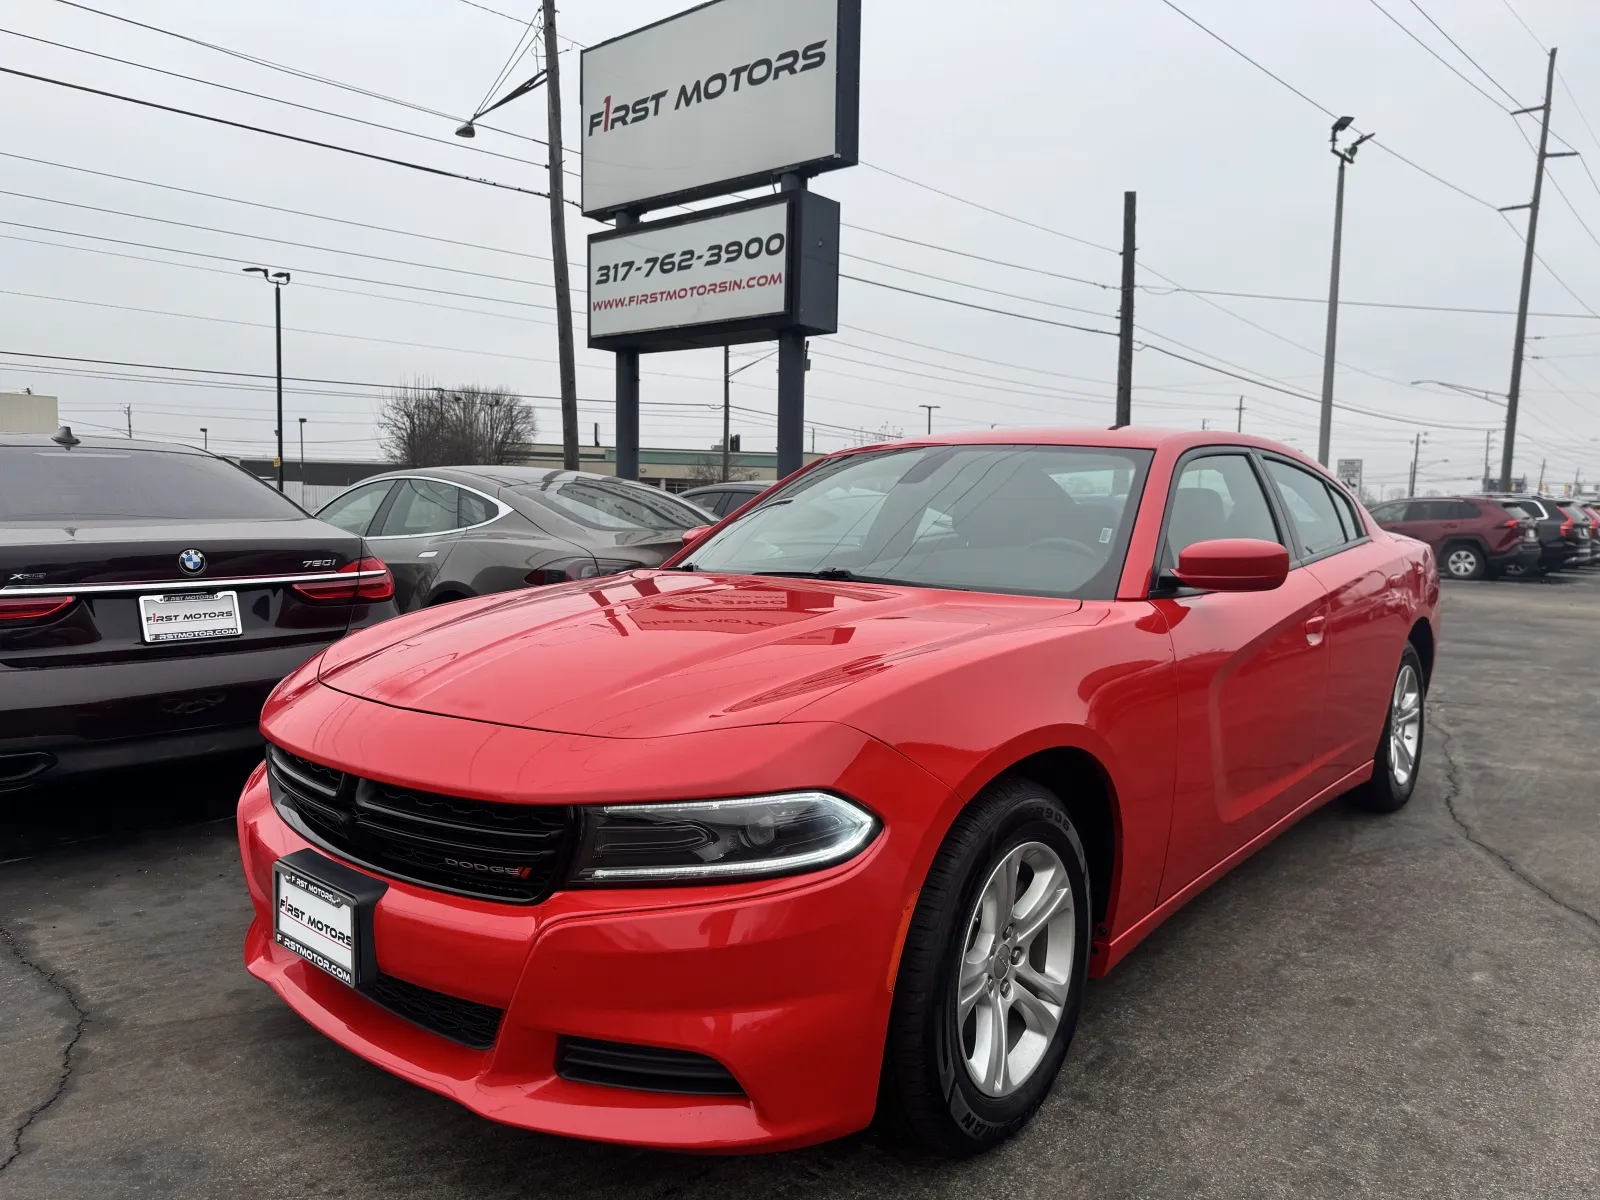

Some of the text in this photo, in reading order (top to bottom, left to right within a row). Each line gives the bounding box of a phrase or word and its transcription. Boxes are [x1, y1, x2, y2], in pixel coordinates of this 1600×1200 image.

[674, 39, 828, 111] MOTORS
[595, 232, 785, 286] 317-762-3900
[592, 272, 782, 312] WWW.FIRSTMOTORSIN.COM
[183, 610, 233, 620] MOTORS
[444, 857, 520, 876] DODGE
[291, 875, 334, 902] FRST MOTORS
[307, 915, 352, 946] MOTORS
